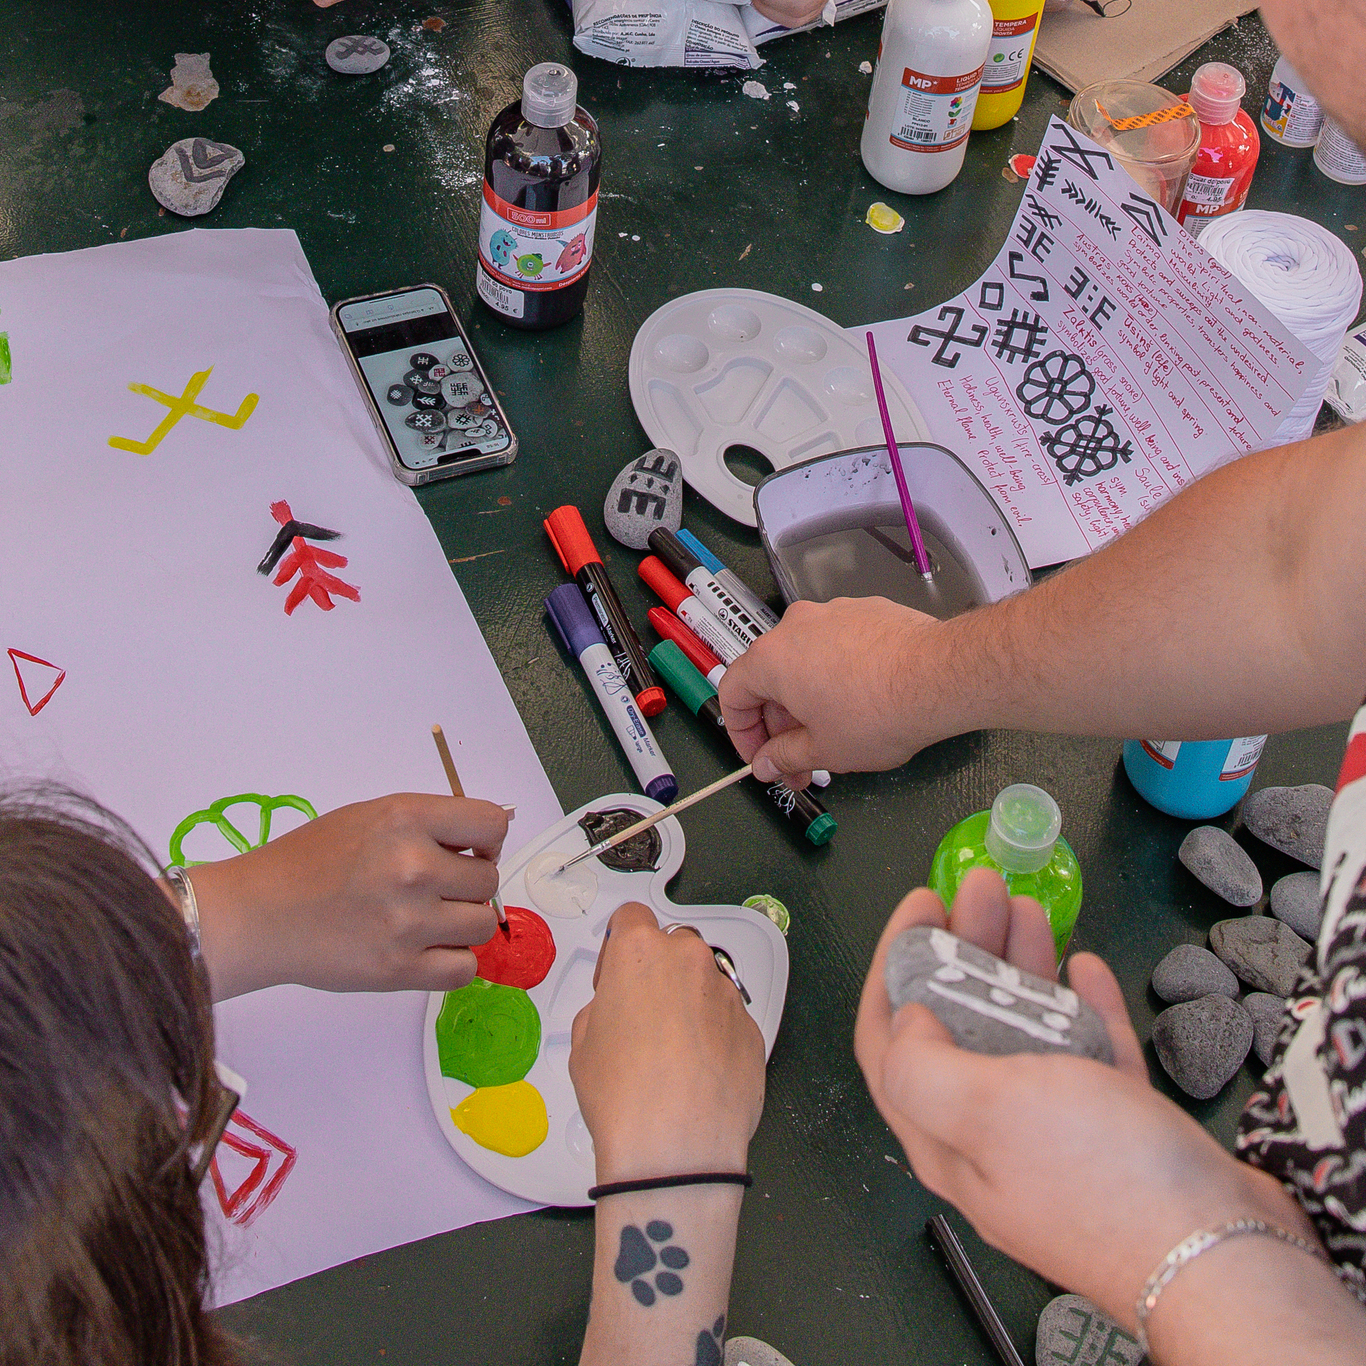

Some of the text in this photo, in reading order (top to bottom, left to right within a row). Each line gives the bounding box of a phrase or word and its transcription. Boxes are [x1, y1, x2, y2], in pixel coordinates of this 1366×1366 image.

[995, 20, 1027, 28] TEMPERA
[1195, 204, 1220, 214] MP
[1076, 234, 1112, 270] Austras
[1131, 226, 1160, 260] Laima
[1177, 237, 1193, 258] The
[1117, 260, 1167, 308] good fortune
[1207, 257, 1232, 279] (god)
[499, 284, 513, 294] povo
[1201, 281, 1224, 304] Light
[1225, 307, 1243, 325] and
[495, 301, 509, 312] 4.95
[1128, 238, 1269, 386] Protects and sweeps out the undesired.
[1073, 238, 1113, 285] symbolizes
[1117, 287, 1139, 309] world
[1153, 333, 1183, 366] linking
[1199, 380, 1231, 408] present
[1226, 408, 1247, 424] and
[1124, 249, 1281, 416] Symbolic properties, transfers happiness and
[1063, 304, 1146, 404] Zalktis (grass snake)
[1117, 329, 1146, 361] symbol
[1143, 361, 1153, 375] of
[1151, 368, 1169, 390] light
[1168, 391, 1185, 408] and
[1151, 350, 1173, 376] (life)
[937, 379, 968, 414] Eternal
[959, 374, 983, 415] Holiness,
[981, 413, 1003, 445] health,
[1056, 320, 1099, 366] symbolizes
[1087, 366, 1113, 389] good
[1160, 456, 1180, 471] and
[1172, 470, 1190, 486] ins
[1228, 426, 1251, 452] future
[977, 450, 1005, 478] Protect
[989, 484, 1014, 504] from
[1071, 492, 1093, 520] safety,
[1094, 480, 1123, 518] harmony,
[593, 595, 617, 645] Permanent Marker
[635, 740, 643, 754] large
[644, 737, 656, 757] Marker
